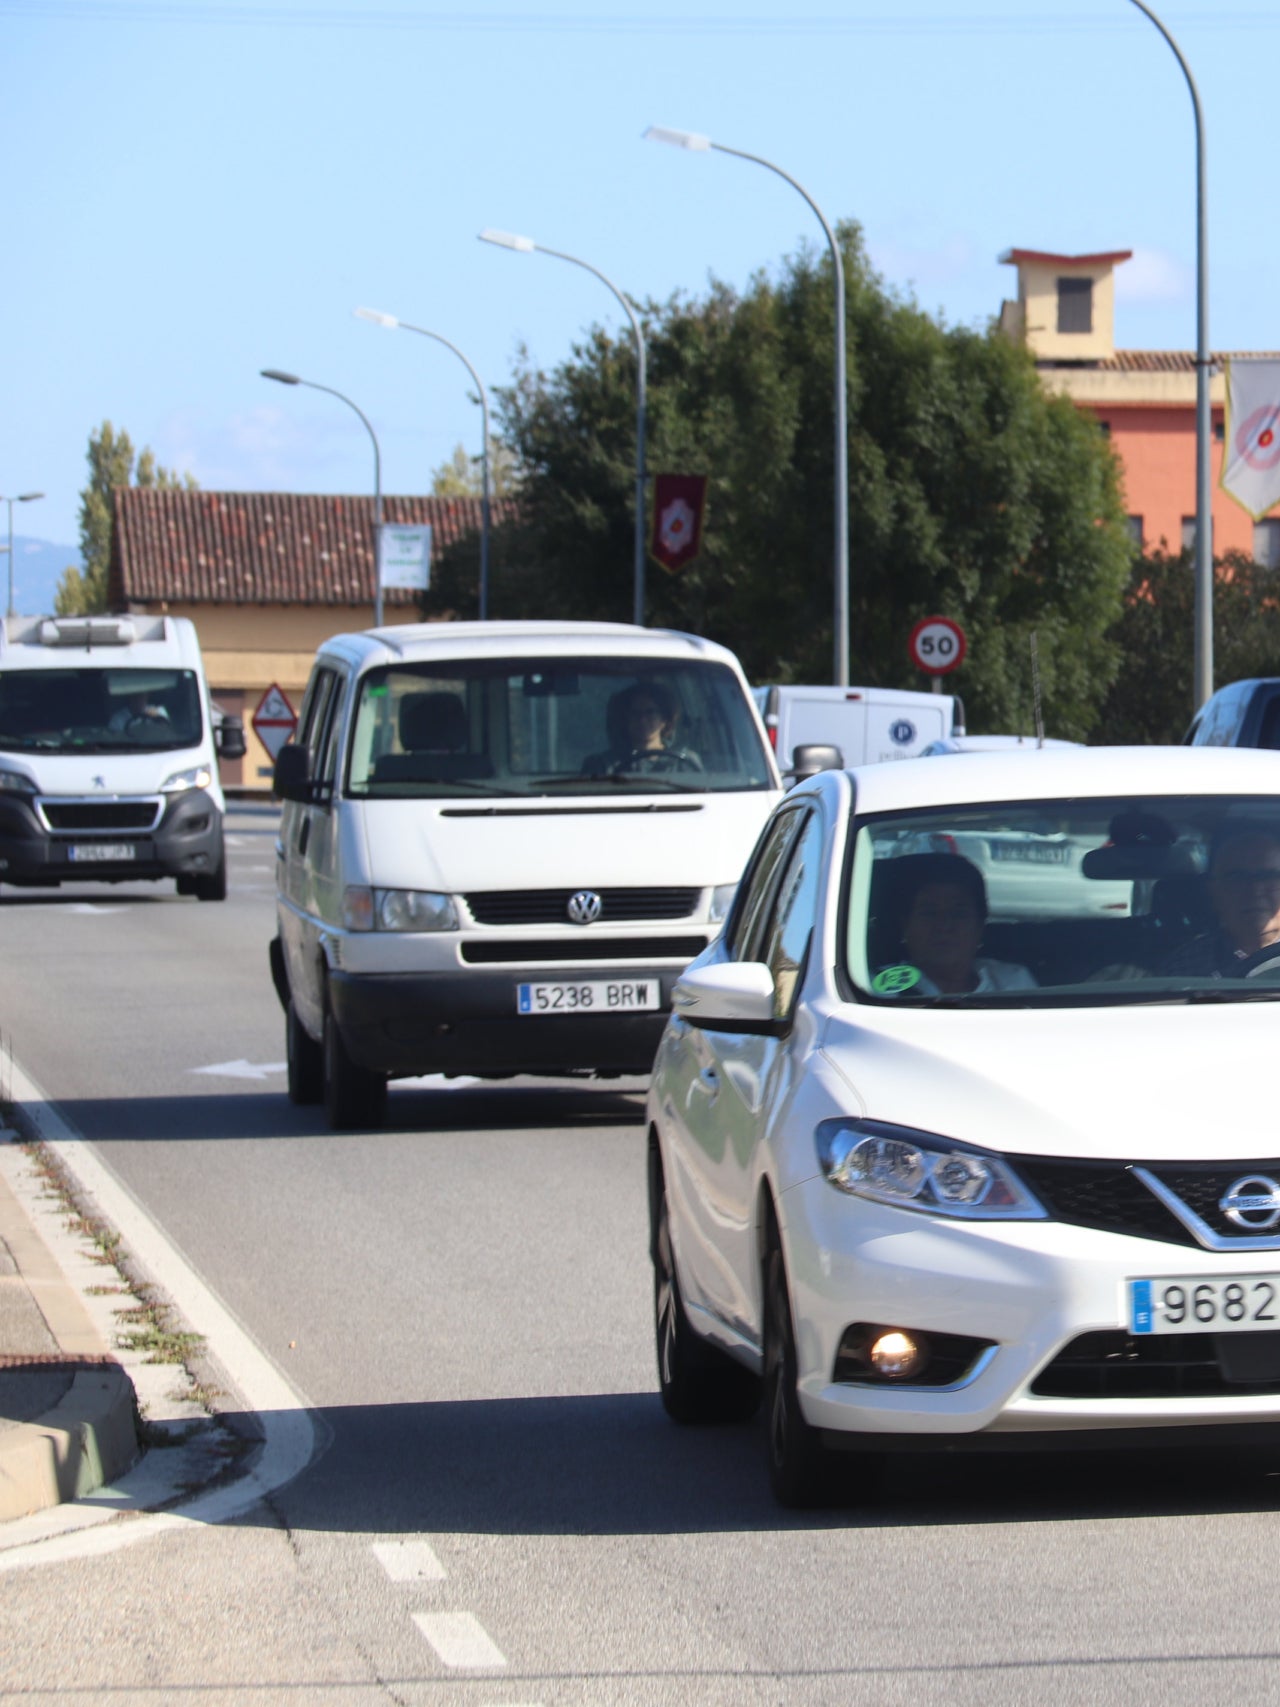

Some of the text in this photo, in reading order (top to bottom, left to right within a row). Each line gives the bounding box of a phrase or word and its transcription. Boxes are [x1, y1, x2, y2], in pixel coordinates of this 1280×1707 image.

[922, 636, 953, 655] 50
[535, 985, 594, 1010] 5238
[607, 984, 648, 1007] BRW
[1161, 1281, 1276, 1324] 9682
